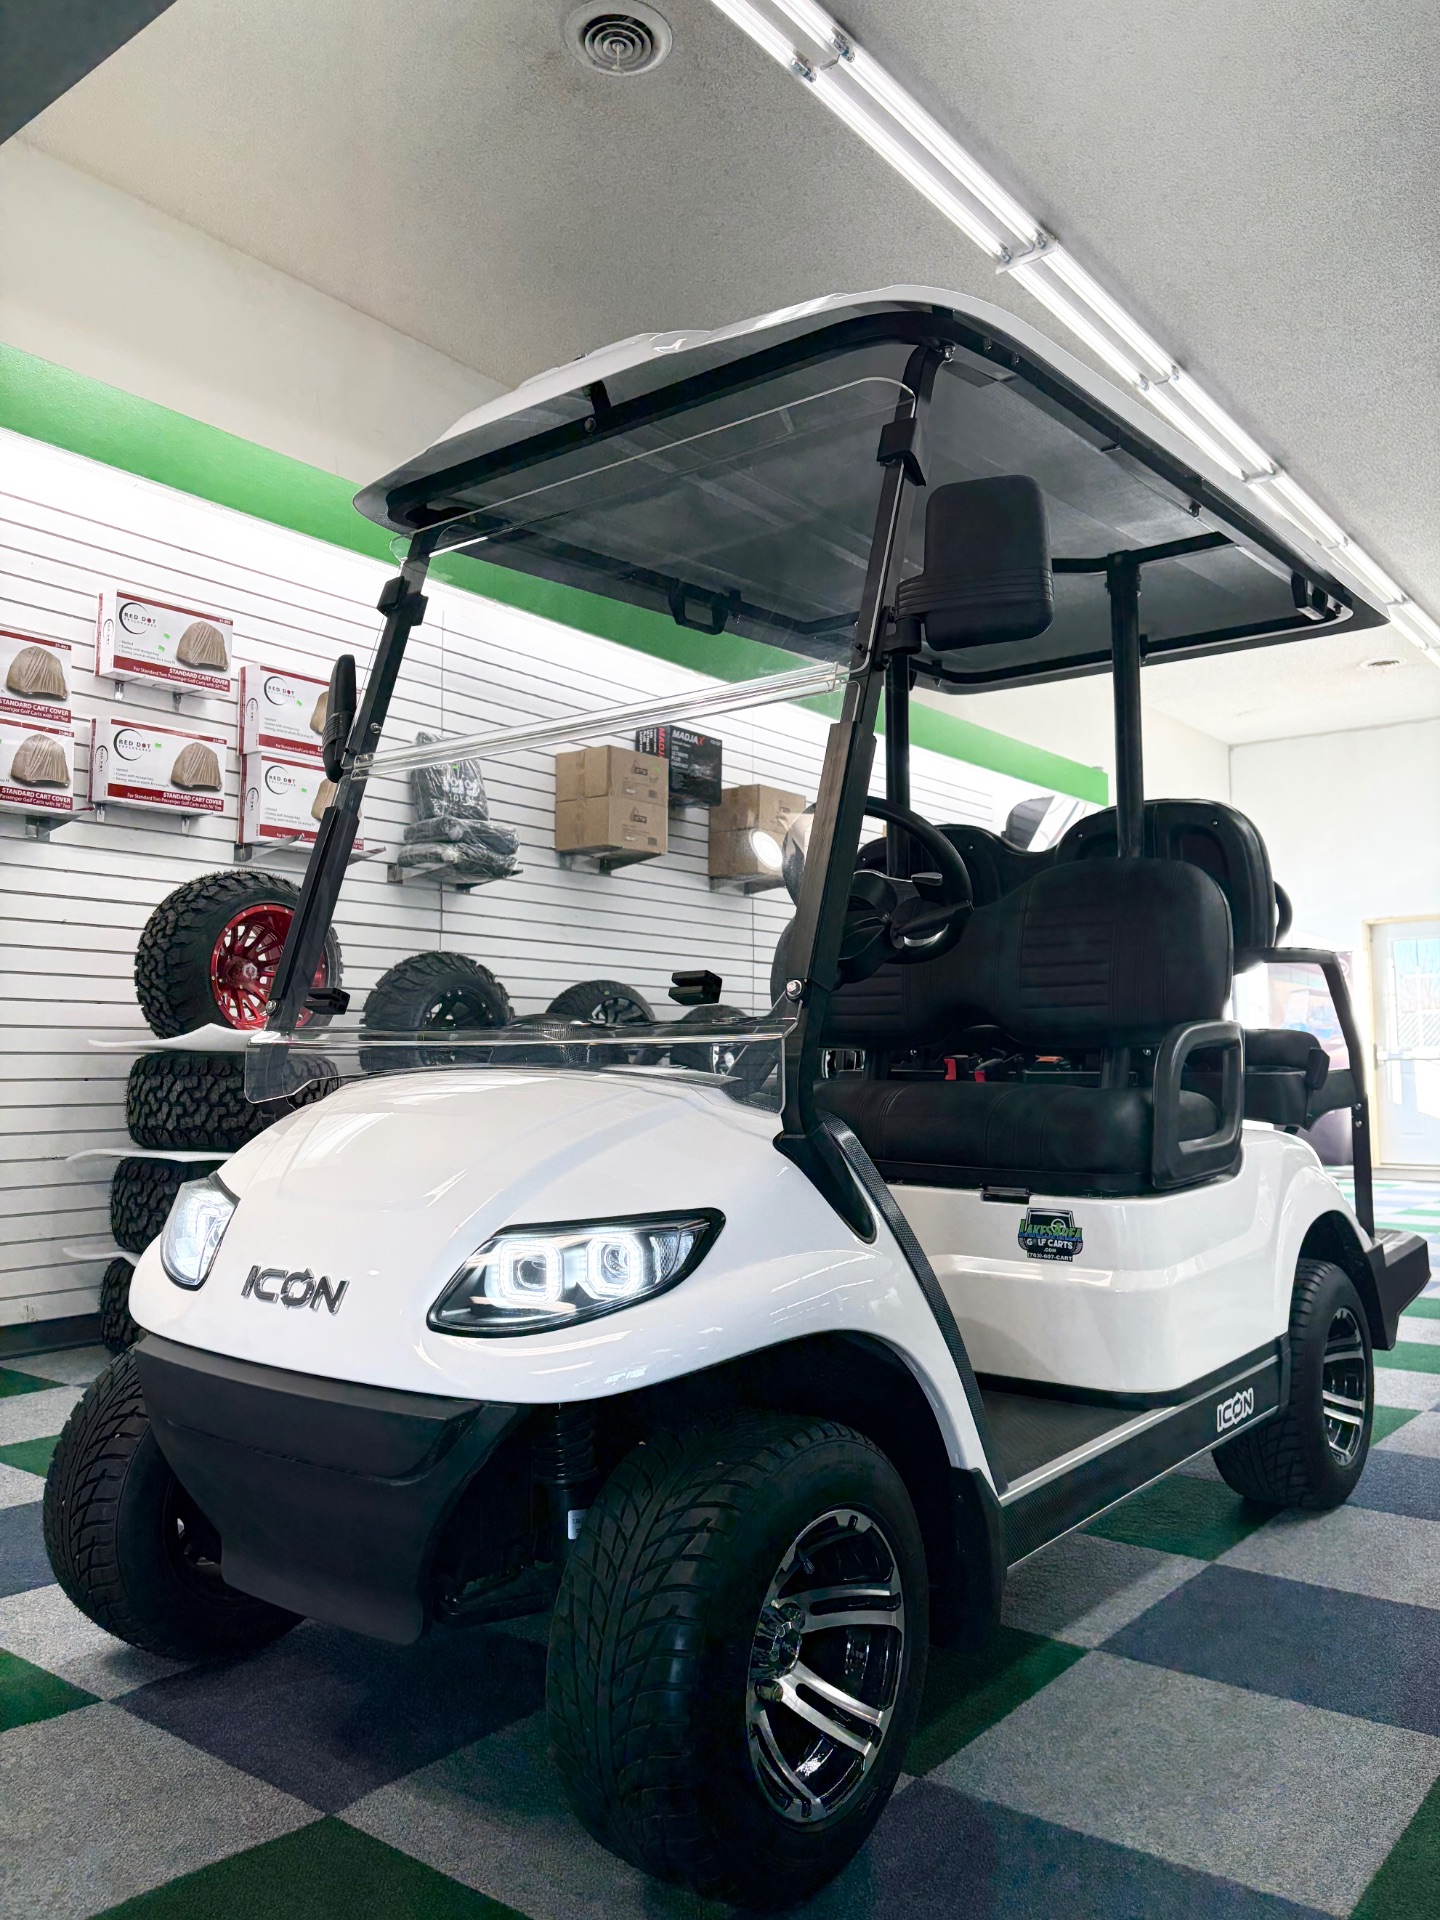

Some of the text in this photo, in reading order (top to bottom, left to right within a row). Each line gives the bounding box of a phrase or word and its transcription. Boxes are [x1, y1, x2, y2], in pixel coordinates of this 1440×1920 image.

[168, 674, 188, 682] Passenger
[169, 668, 197, 678] STANDARD
[672, 730, 705, 746] MADJAX
[2, 788, 34, 797] STANDARD
[163, 792, 191, 800] STANDARD
[1018, 1219, 1052, 1237] LAKES
[1048, 1240, 1073, 1250] CARTS
[240, 1264, 350, 1315] ICON
[1217, 1388, 1254, 1432] ICON
